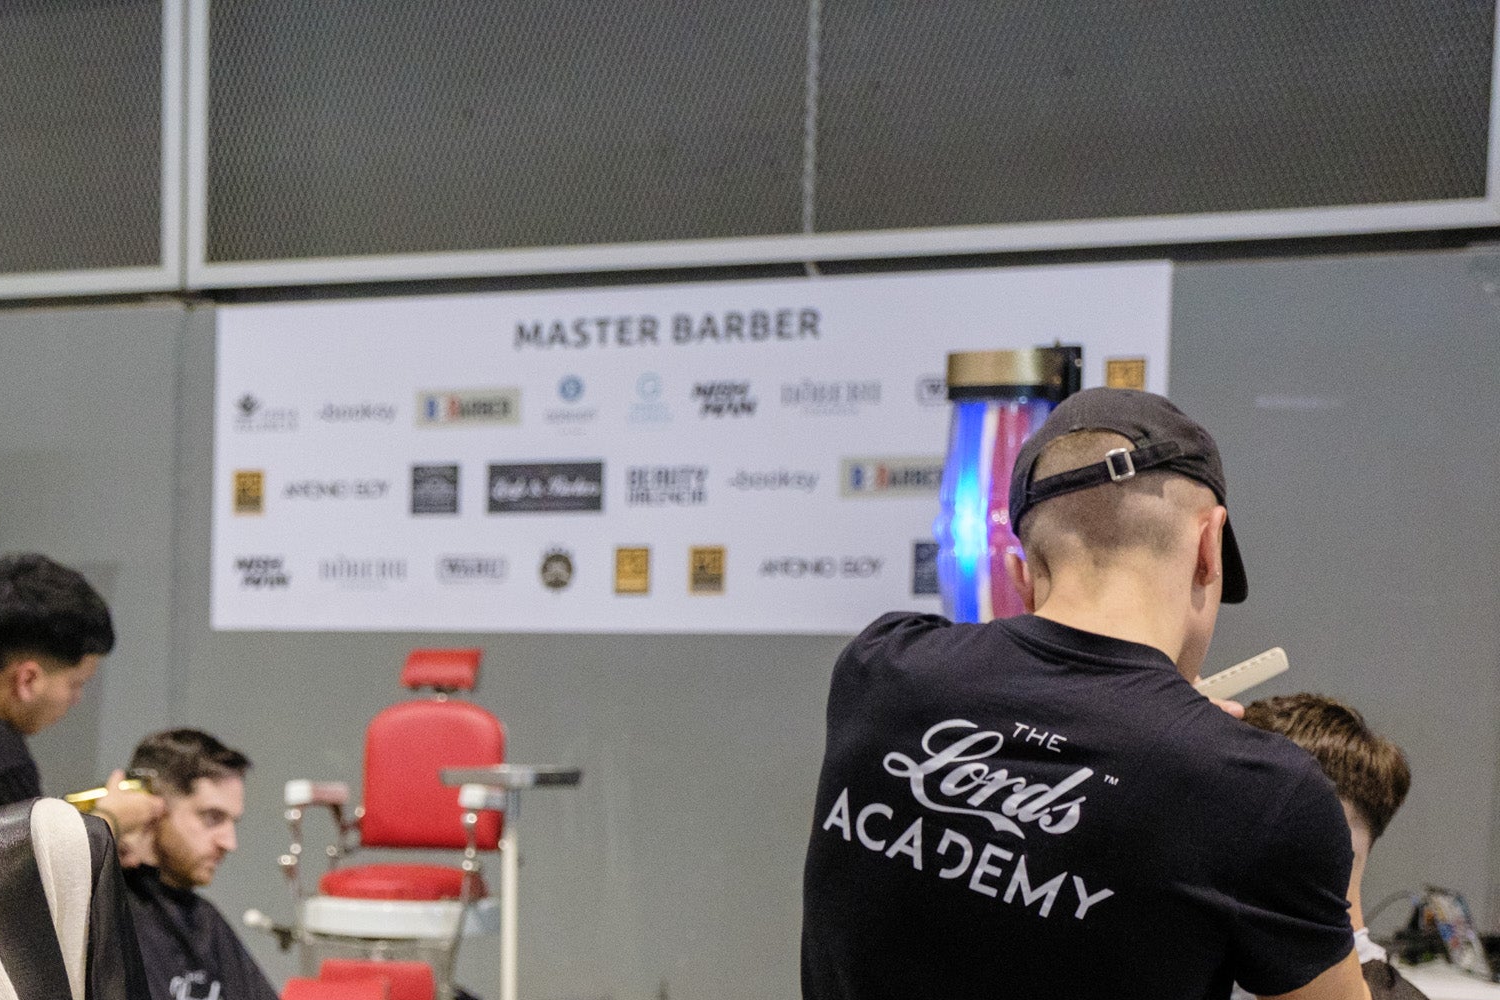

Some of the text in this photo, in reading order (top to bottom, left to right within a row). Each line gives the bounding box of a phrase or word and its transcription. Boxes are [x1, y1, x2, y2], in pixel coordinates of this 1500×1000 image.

[514, 308, 821, 350] MASTER BARBER
[1012, 721, 1068, 753] THE
[882, 718, 1095, 840] Lords
[822, 787, 1115, 920] ACADEMY
